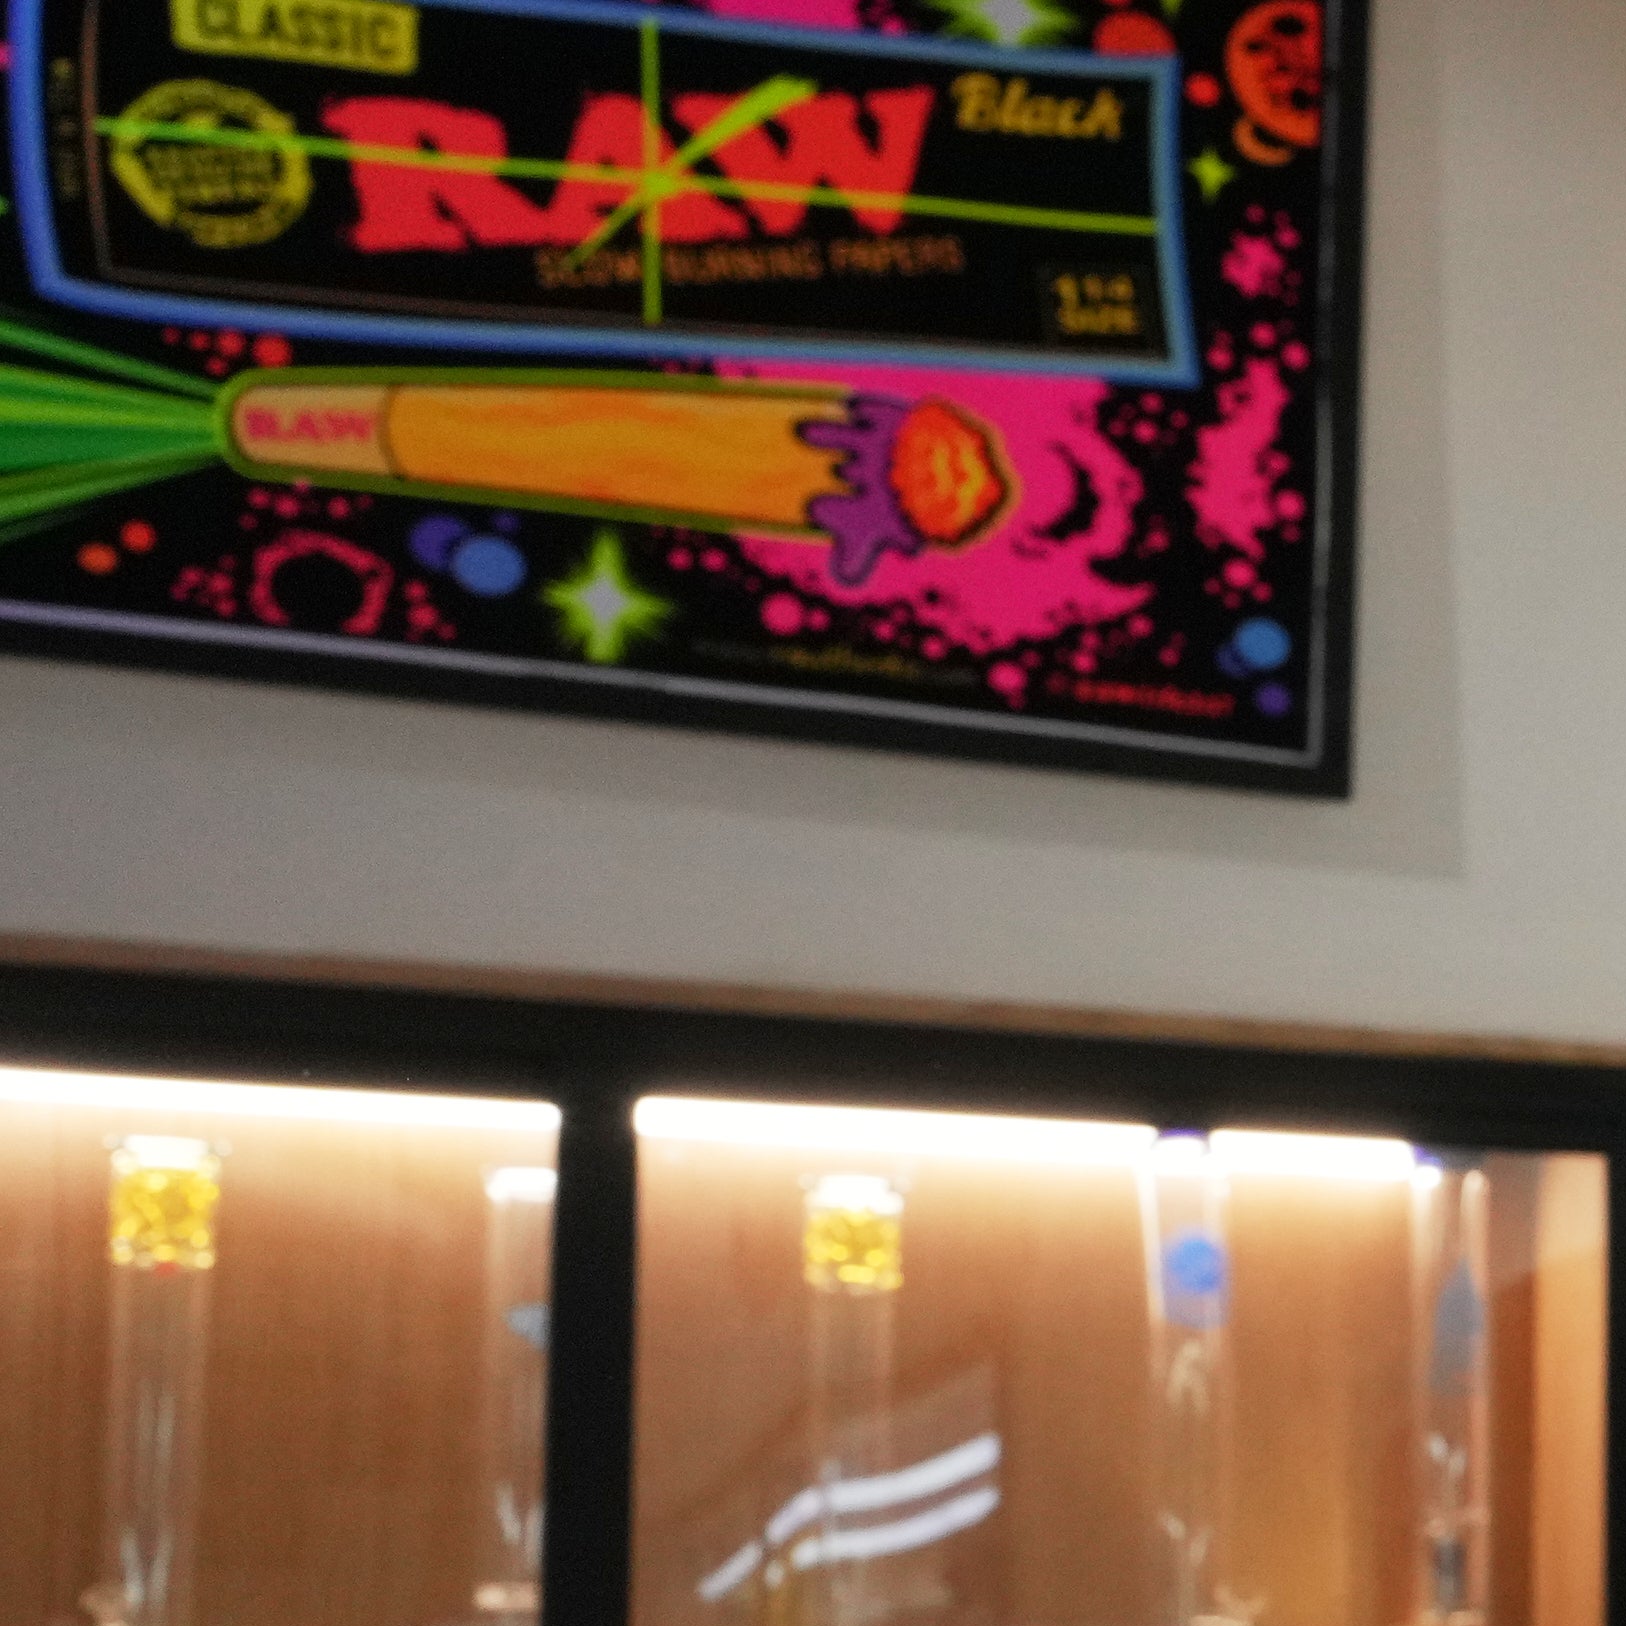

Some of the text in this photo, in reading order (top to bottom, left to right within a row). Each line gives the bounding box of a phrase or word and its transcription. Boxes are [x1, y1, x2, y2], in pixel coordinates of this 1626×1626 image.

[198, 0, 396, 58] CLASSIC
[951, 72, 1122, 140] Black
[320, 84, 937, 252] RAW
[664, 239, 822, 283] BURNING
[828, 236, 965, 275] PAPERS
[243, 404, 378, 443] RAW
